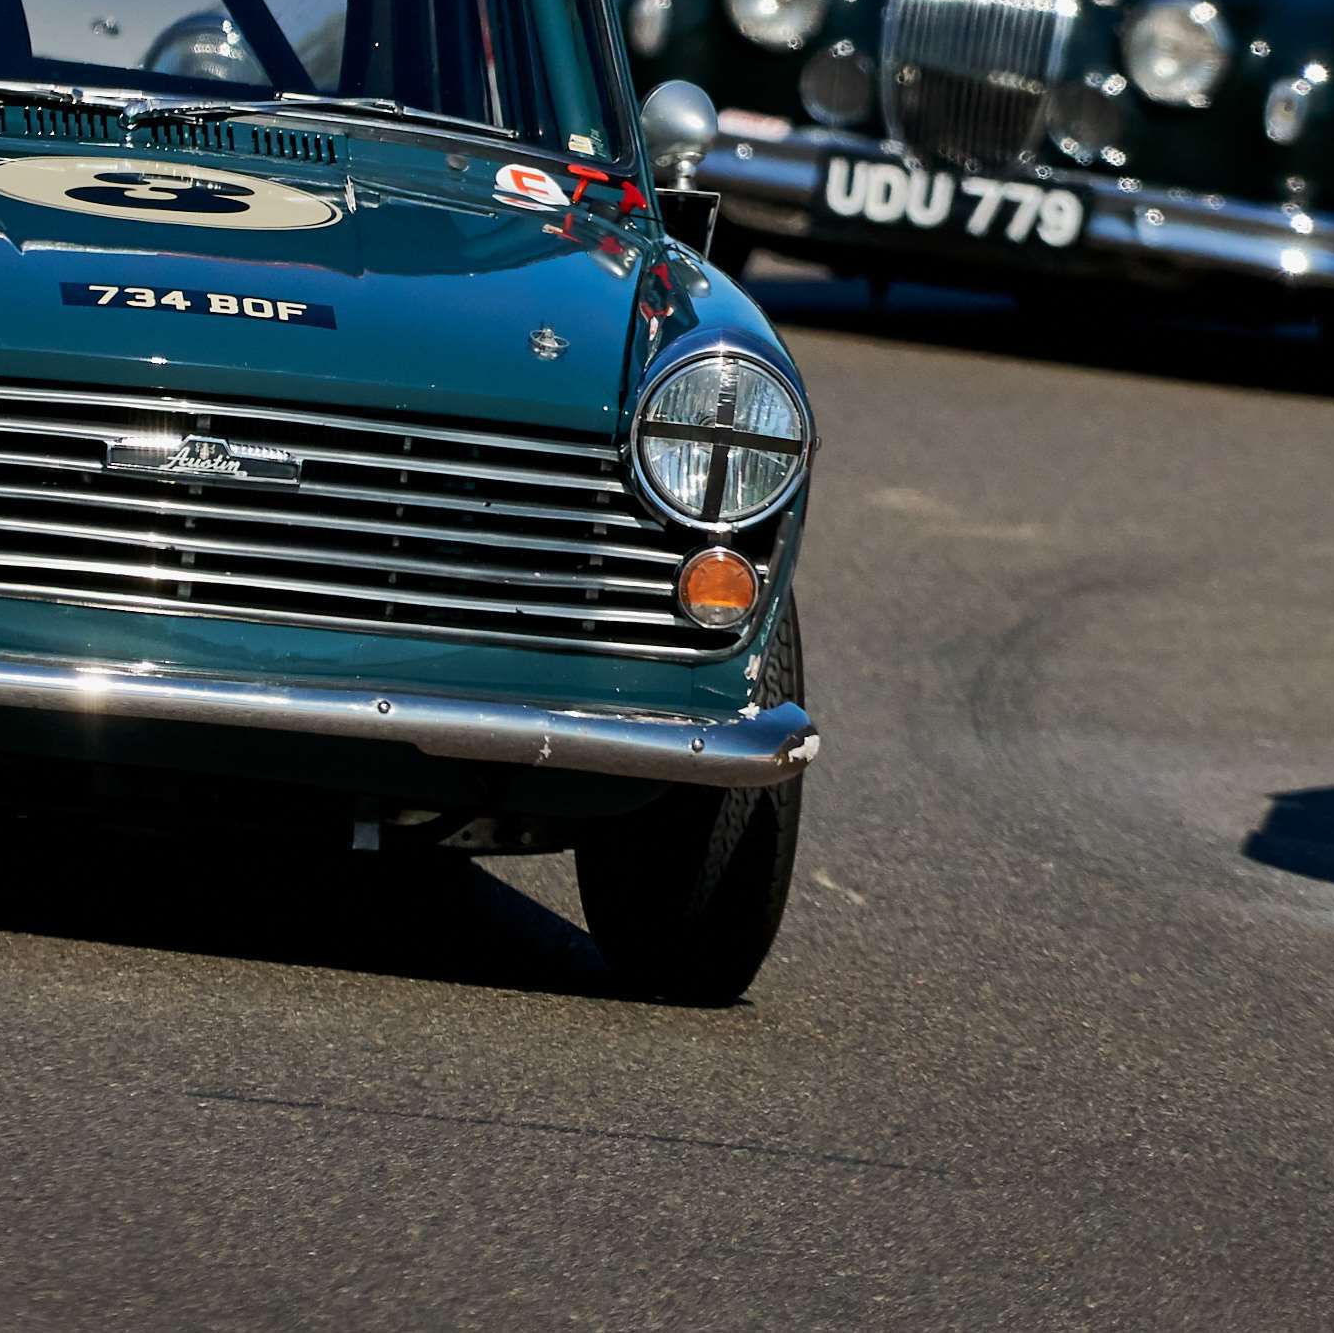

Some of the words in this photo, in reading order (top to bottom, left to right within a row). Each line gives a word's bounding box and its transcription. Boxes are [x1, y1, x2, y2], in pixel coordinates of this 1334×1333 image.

[63, 171, 256, 214] 3
[826, 159, 954, 227] UDU
[962, 177, 1083, 246] 779
[88, 284, 192, 311] 734
[207, 293, 308, 321] BOF
[160, 446, 249, 477] Austin
